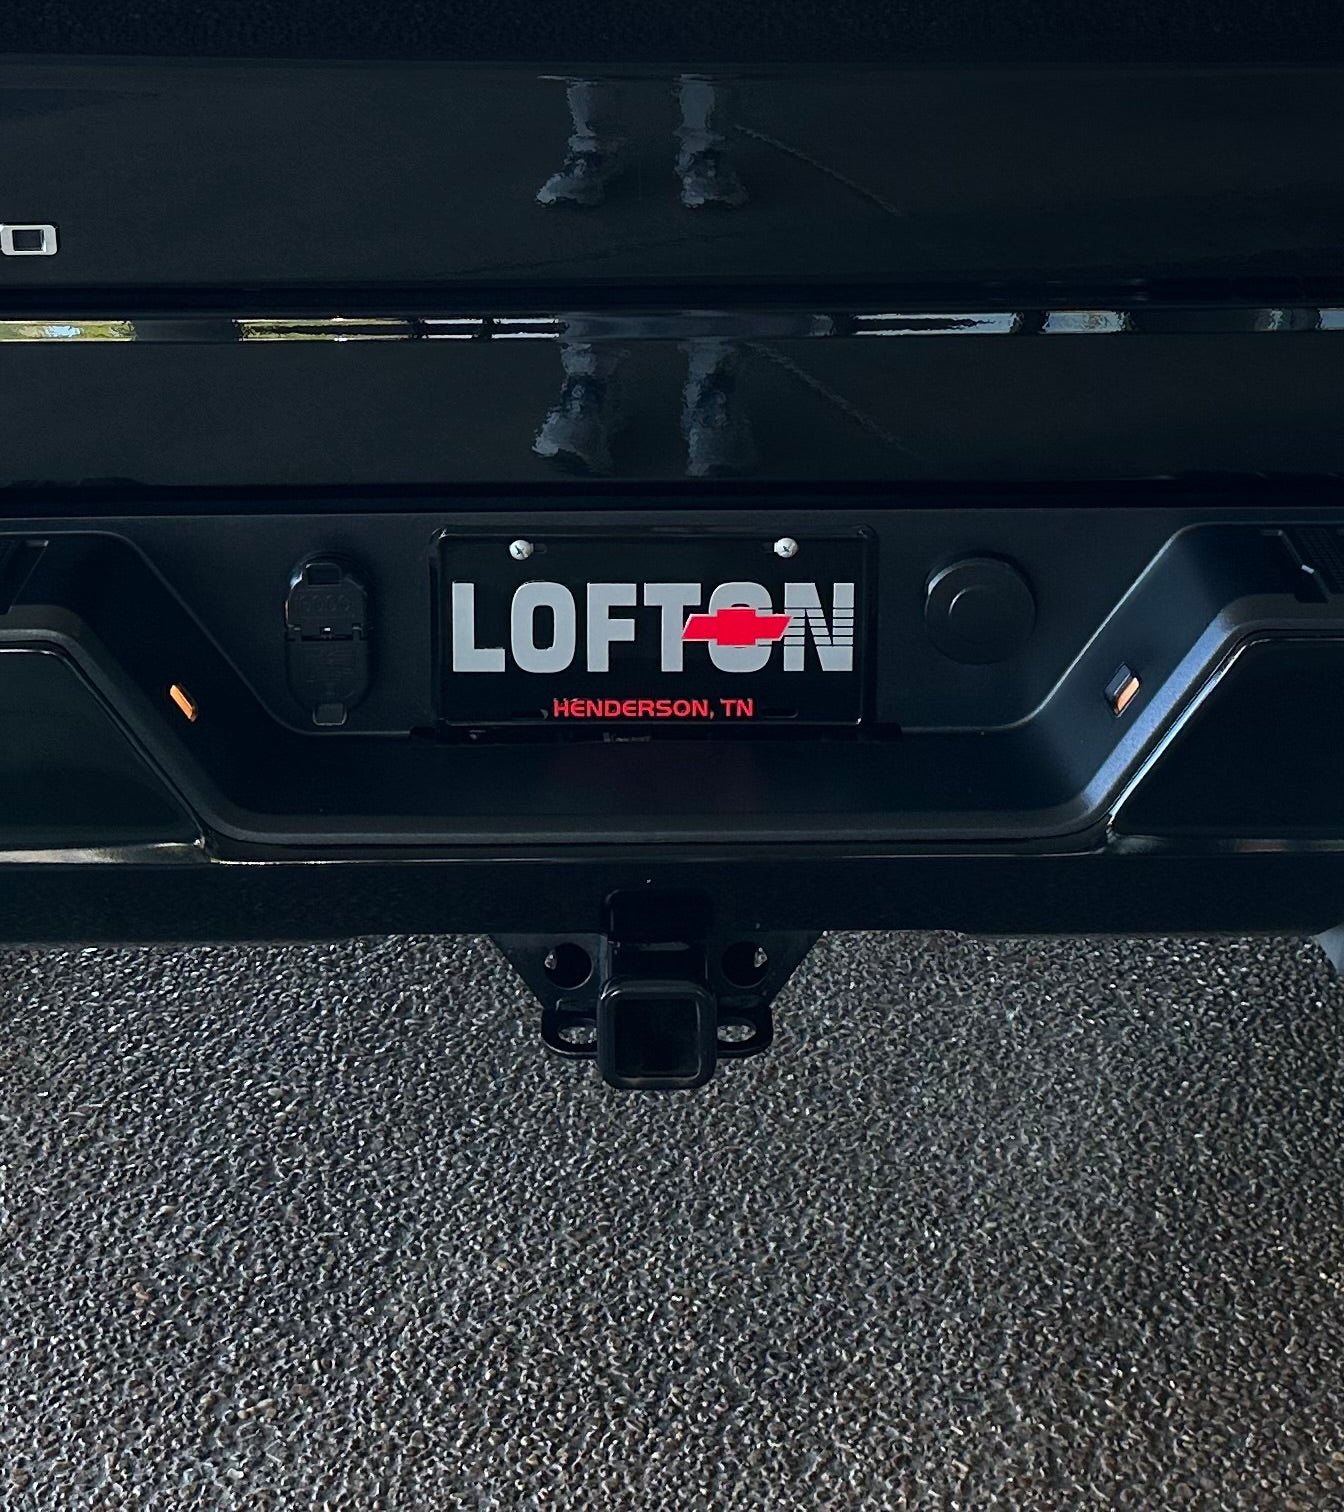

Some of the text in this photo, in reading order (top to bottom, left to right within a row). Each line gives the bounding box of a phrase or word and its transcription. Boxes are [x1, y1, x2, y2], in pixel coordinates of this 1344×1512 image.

[452, 581, 855, 673] LOFTON
[553, 698, 753, 720] HENDERSON, TN
